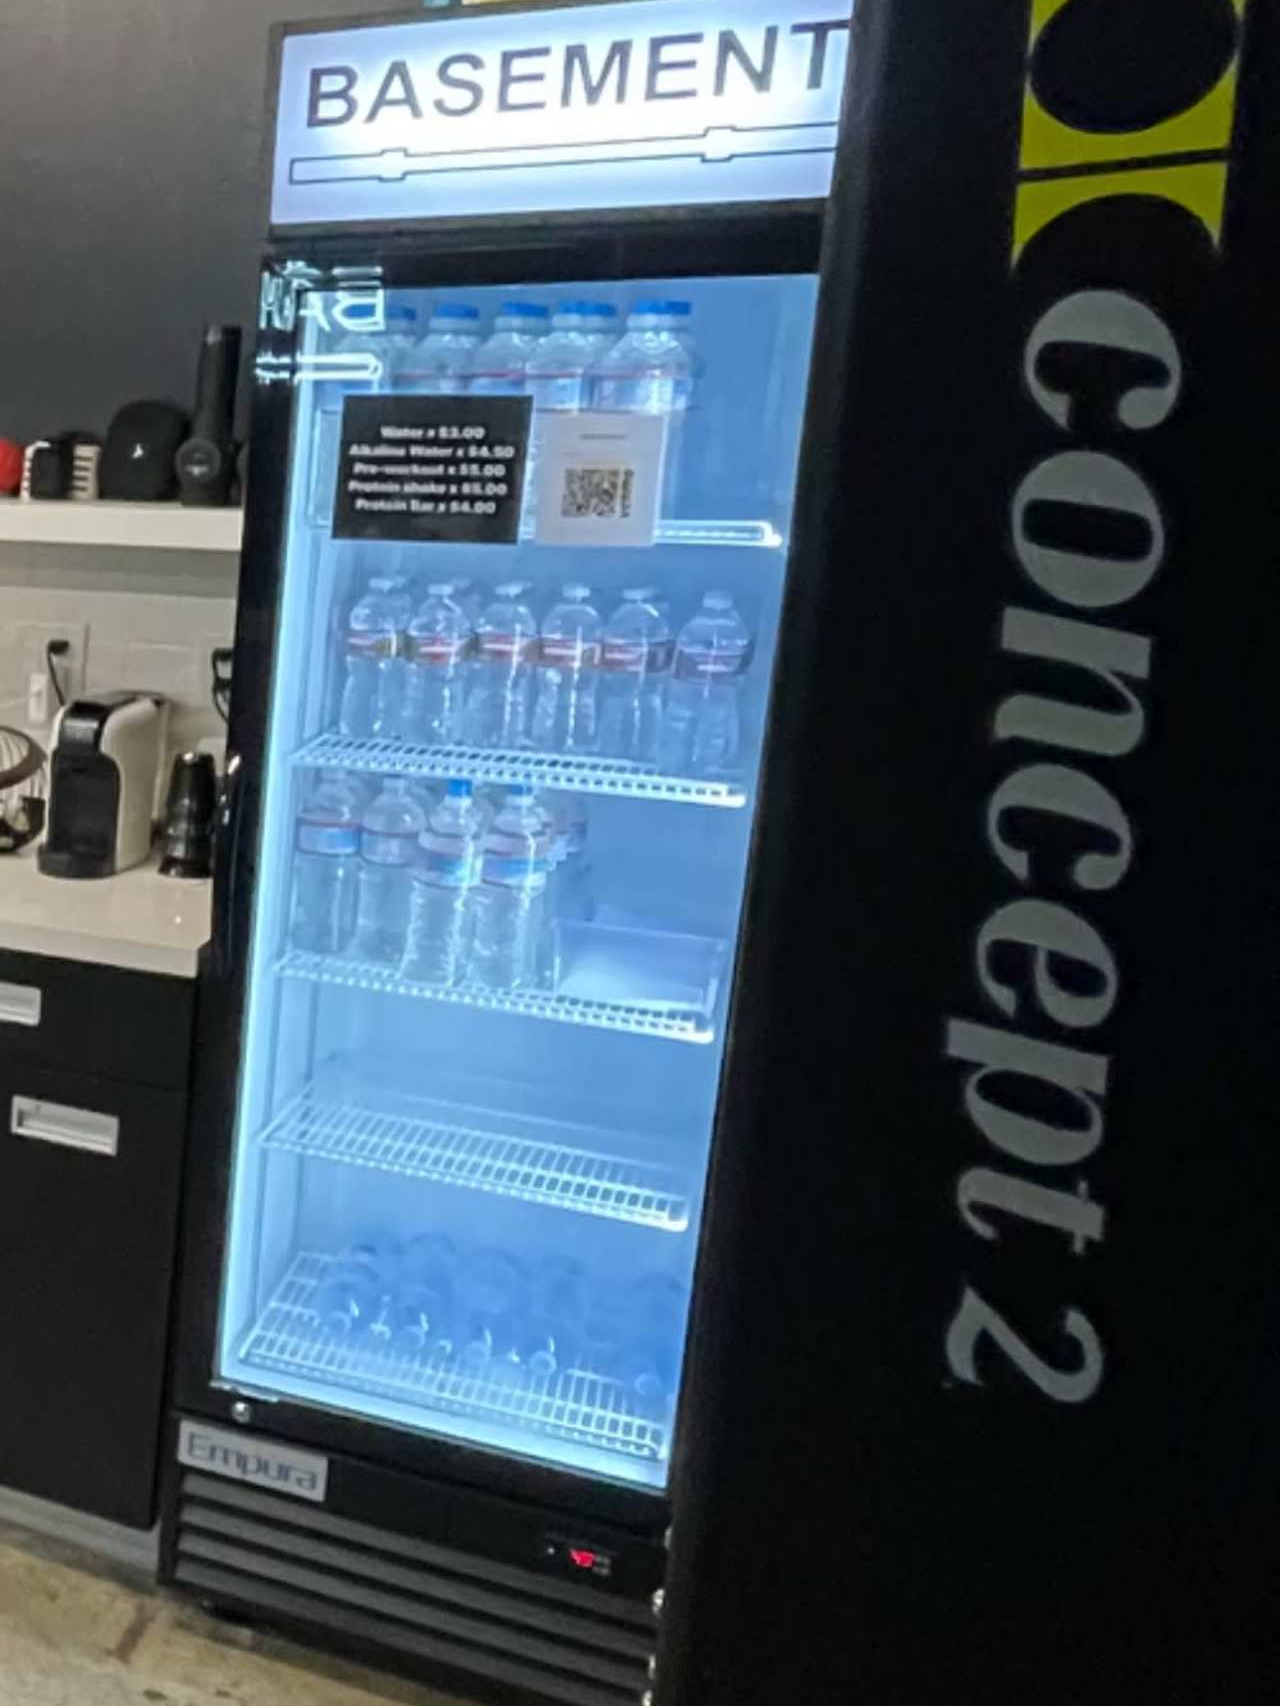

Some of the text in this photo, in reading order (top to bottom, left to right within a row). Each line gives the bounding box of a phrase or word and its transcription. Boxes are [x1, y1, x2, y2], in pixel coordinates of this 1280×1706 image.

[306, 20, 850, 128] BASEMENT
[379, 425, 424, 439] Water
[348, 443, 406, 457] Alkaline
[409, 444, 453, 457] Water
[352, 462, 445, 475] Pre-workout
[347, 480, 401, 493] Protein
[354, 498, 408, 511] Protein
[946, 289, 1182, 1403] concept 2
[187, 1431, 318, 1491] Empura
